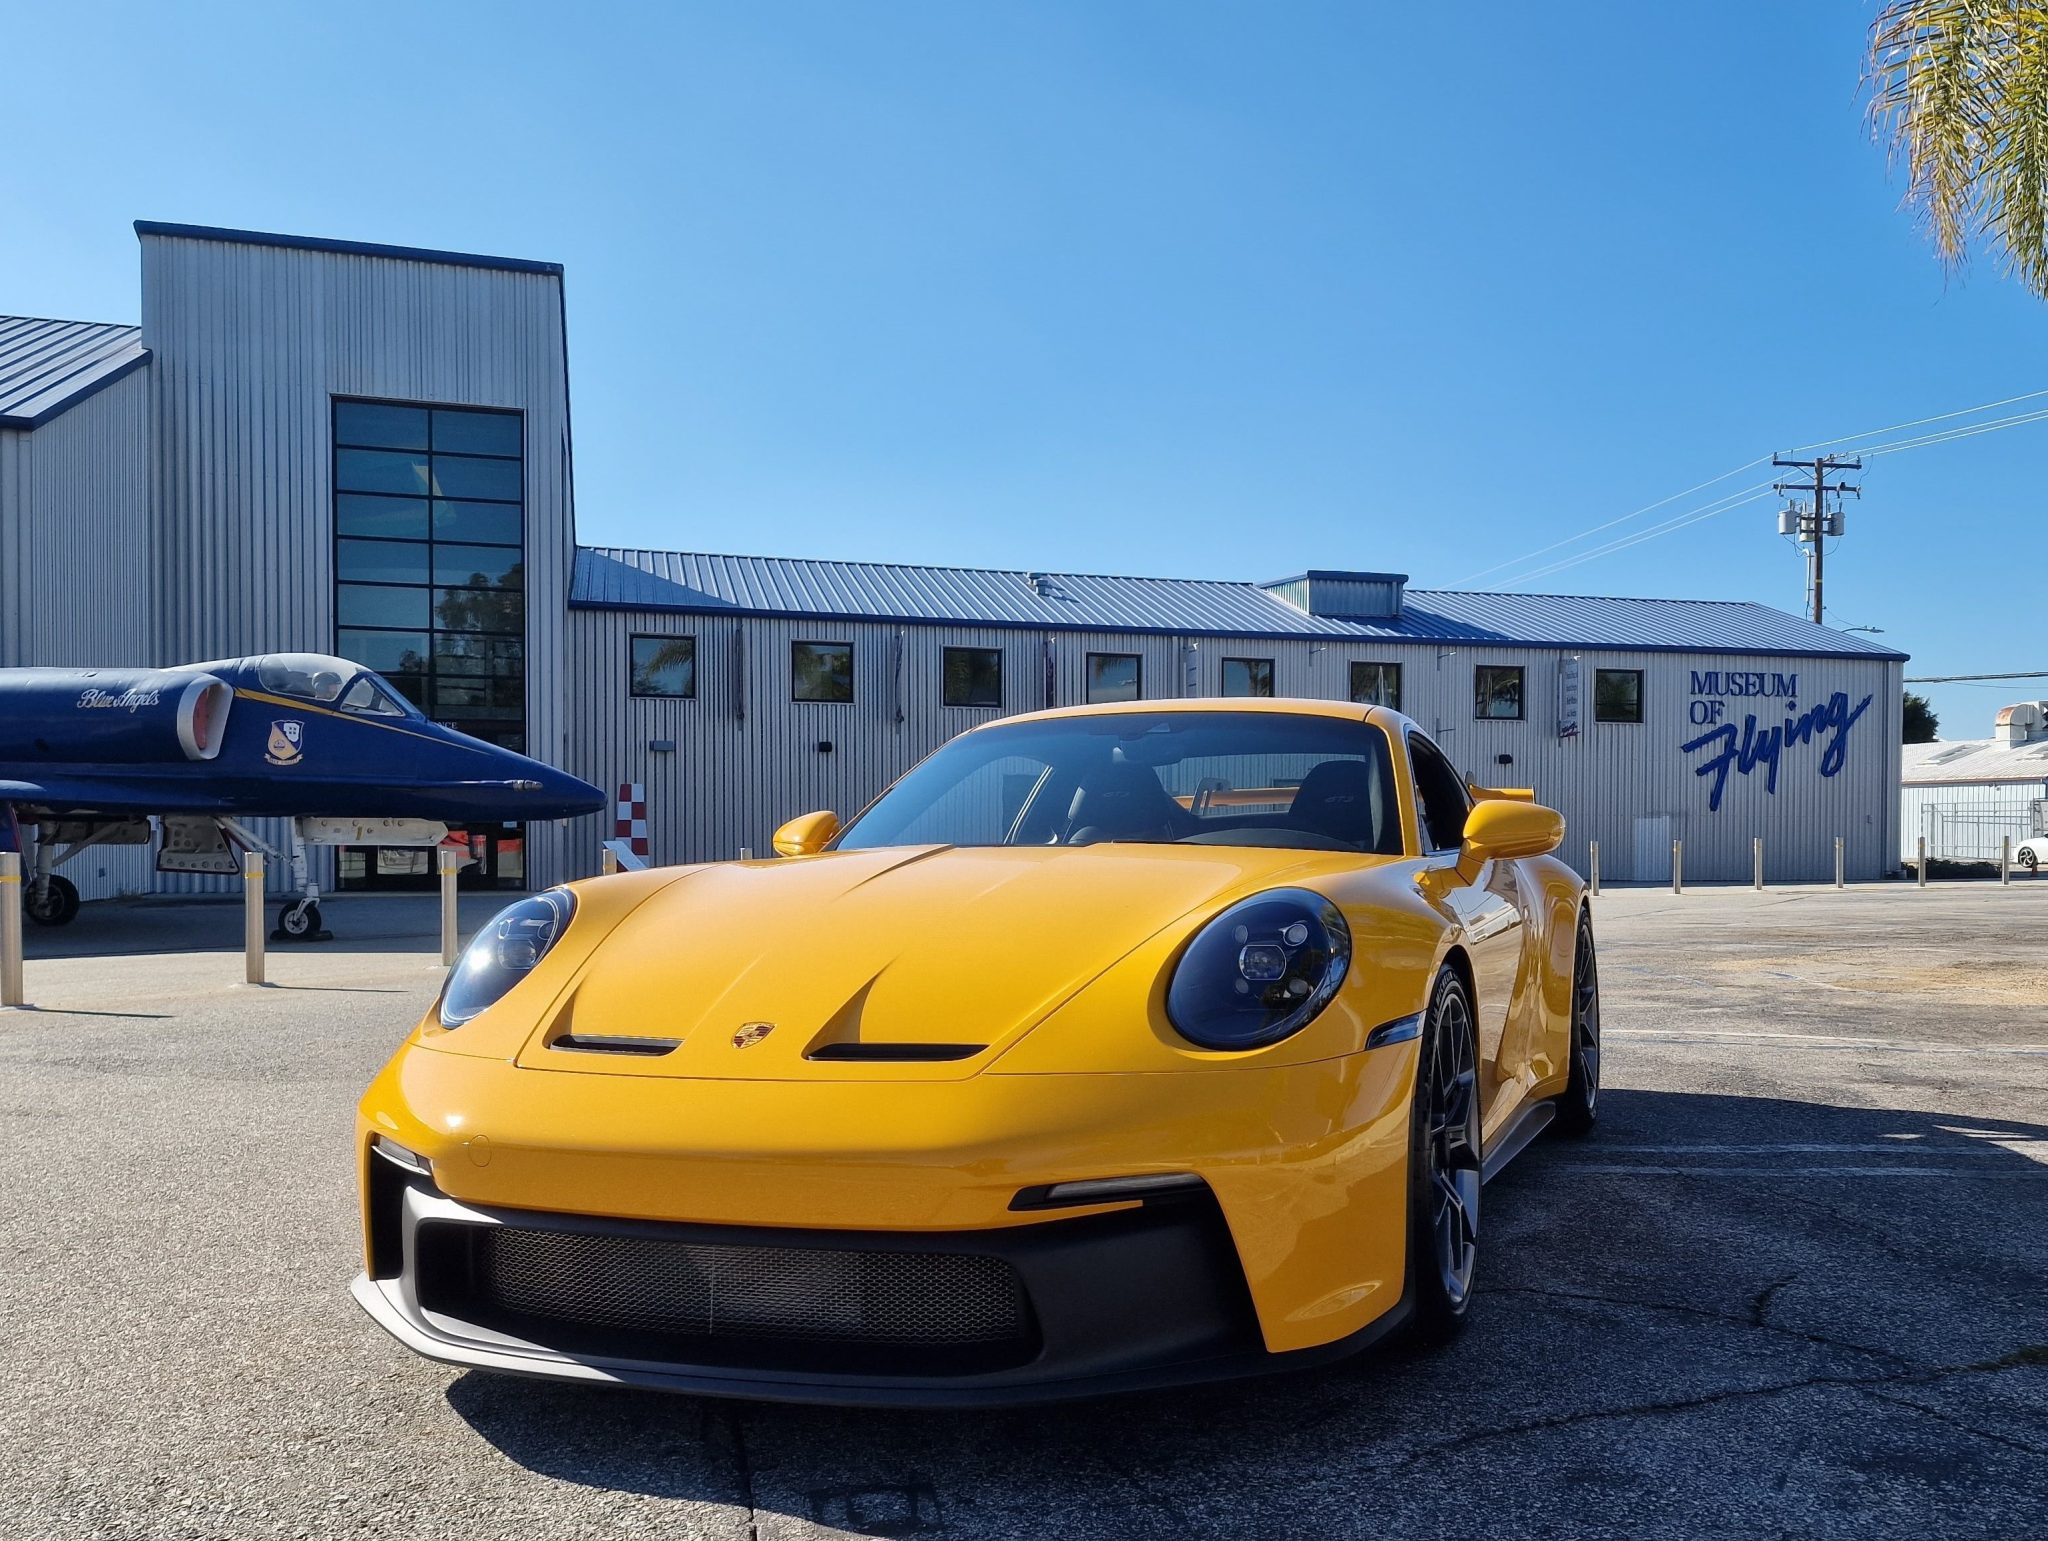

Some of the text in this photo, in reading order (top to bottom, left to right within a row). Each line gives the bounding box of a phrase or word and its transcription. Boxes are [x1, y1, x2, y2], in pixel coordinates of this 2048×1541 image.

[1690, 670, 1798, 698] MUSEUM
[77, 688, 160, 713] Blue Angels
[1690, 700, 1725, 725] OF
[437, 721, 458, 730] NCE
[1681, 692, 1874, 812] Flying
